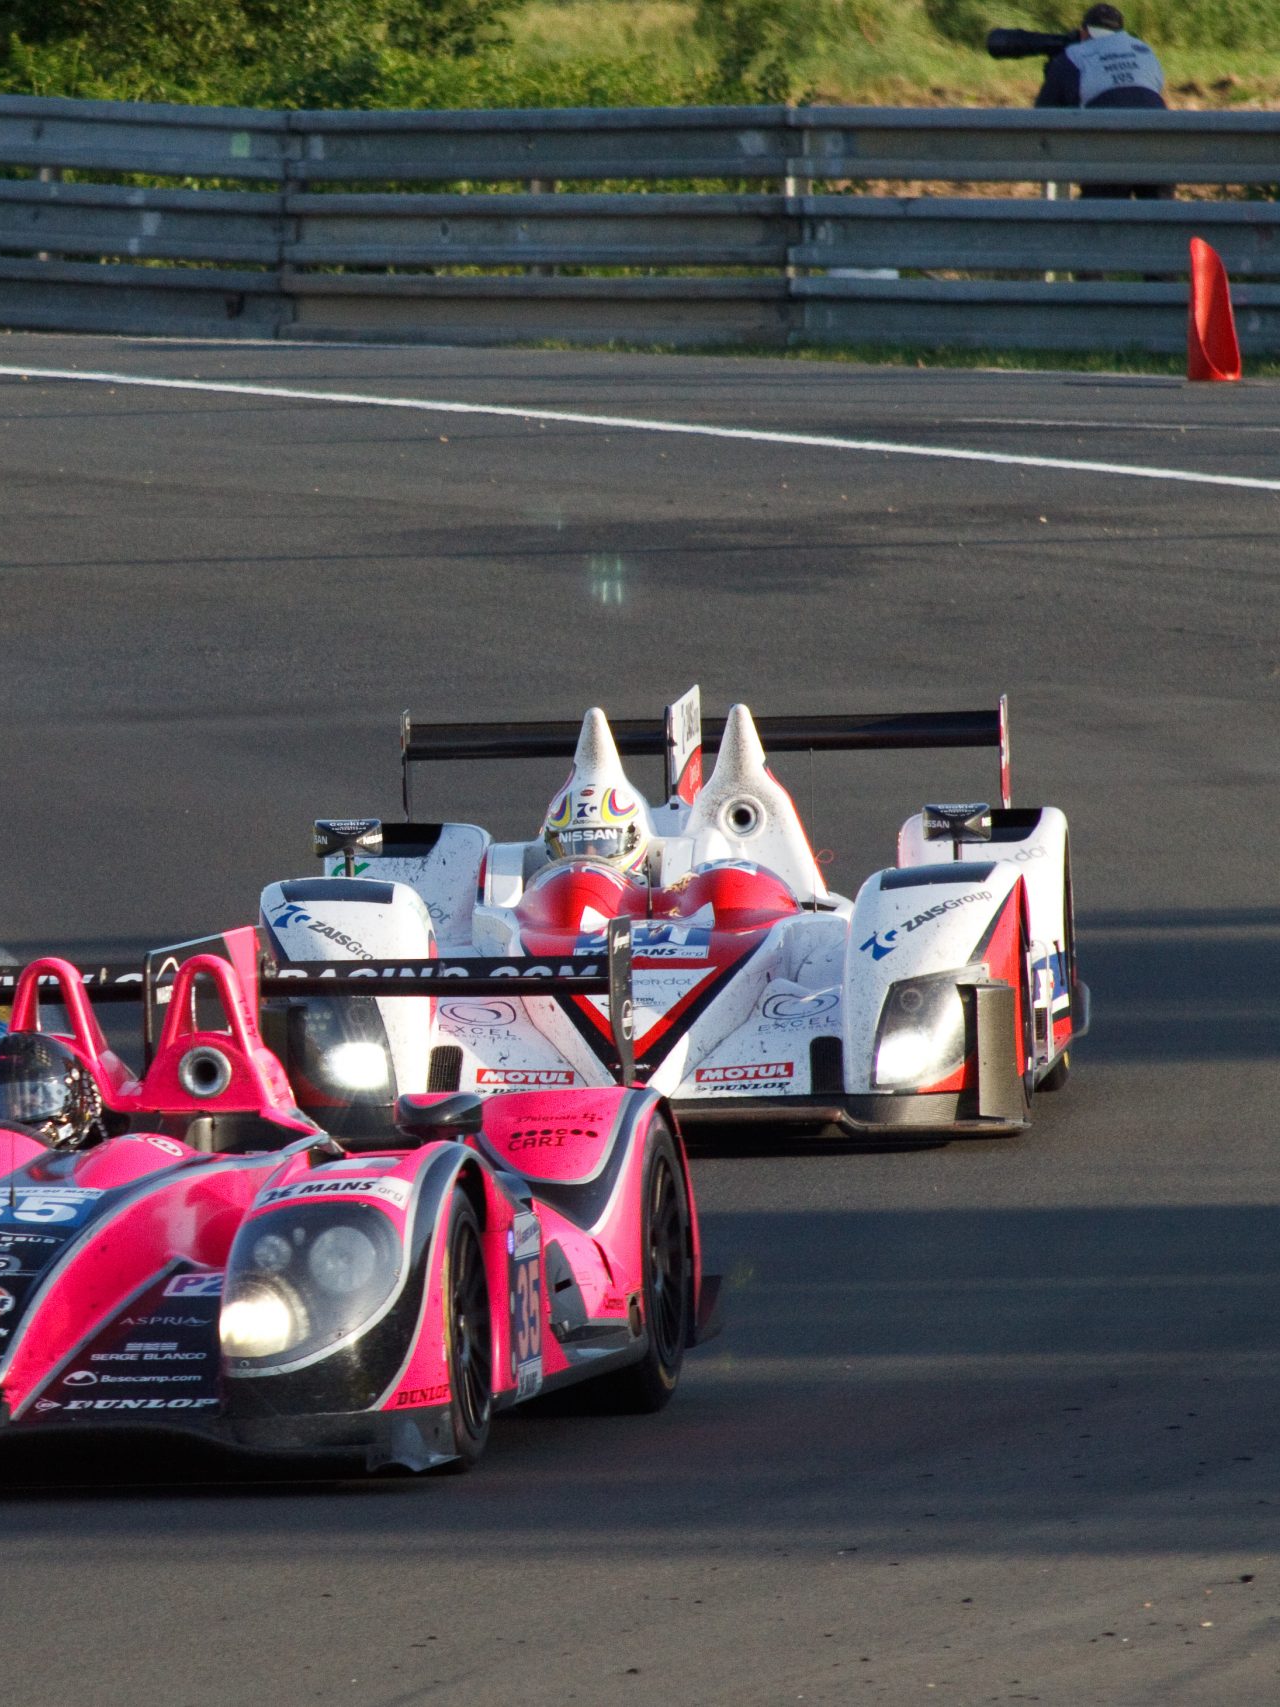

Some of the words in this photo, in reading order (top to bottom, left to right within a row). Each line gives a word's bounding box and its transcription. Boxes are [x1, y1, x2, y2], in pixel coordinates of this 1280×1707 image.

[559, 828, 619, 843] NISSAN
[758, 1015, 837, 1032] EXCEL
[438, 1023, 517, 1038] EXCEL
[481, 1070, 570, 1083] MOTUL
[700, 1064, 790, 1081] MOTUL
[712, 1081, 791, 1092] DUNLOP
[299, 1181, 376, 1194] MANS
[516, 1258, 541, 1361] 35
[119, 1316, 200, 1325] ASPRIA
[90, 1353, 140, 1361] SERGE
[143, 1352, 208, 1360] BLANCO
[62, 1398, 220, 1410] DUNLOP
